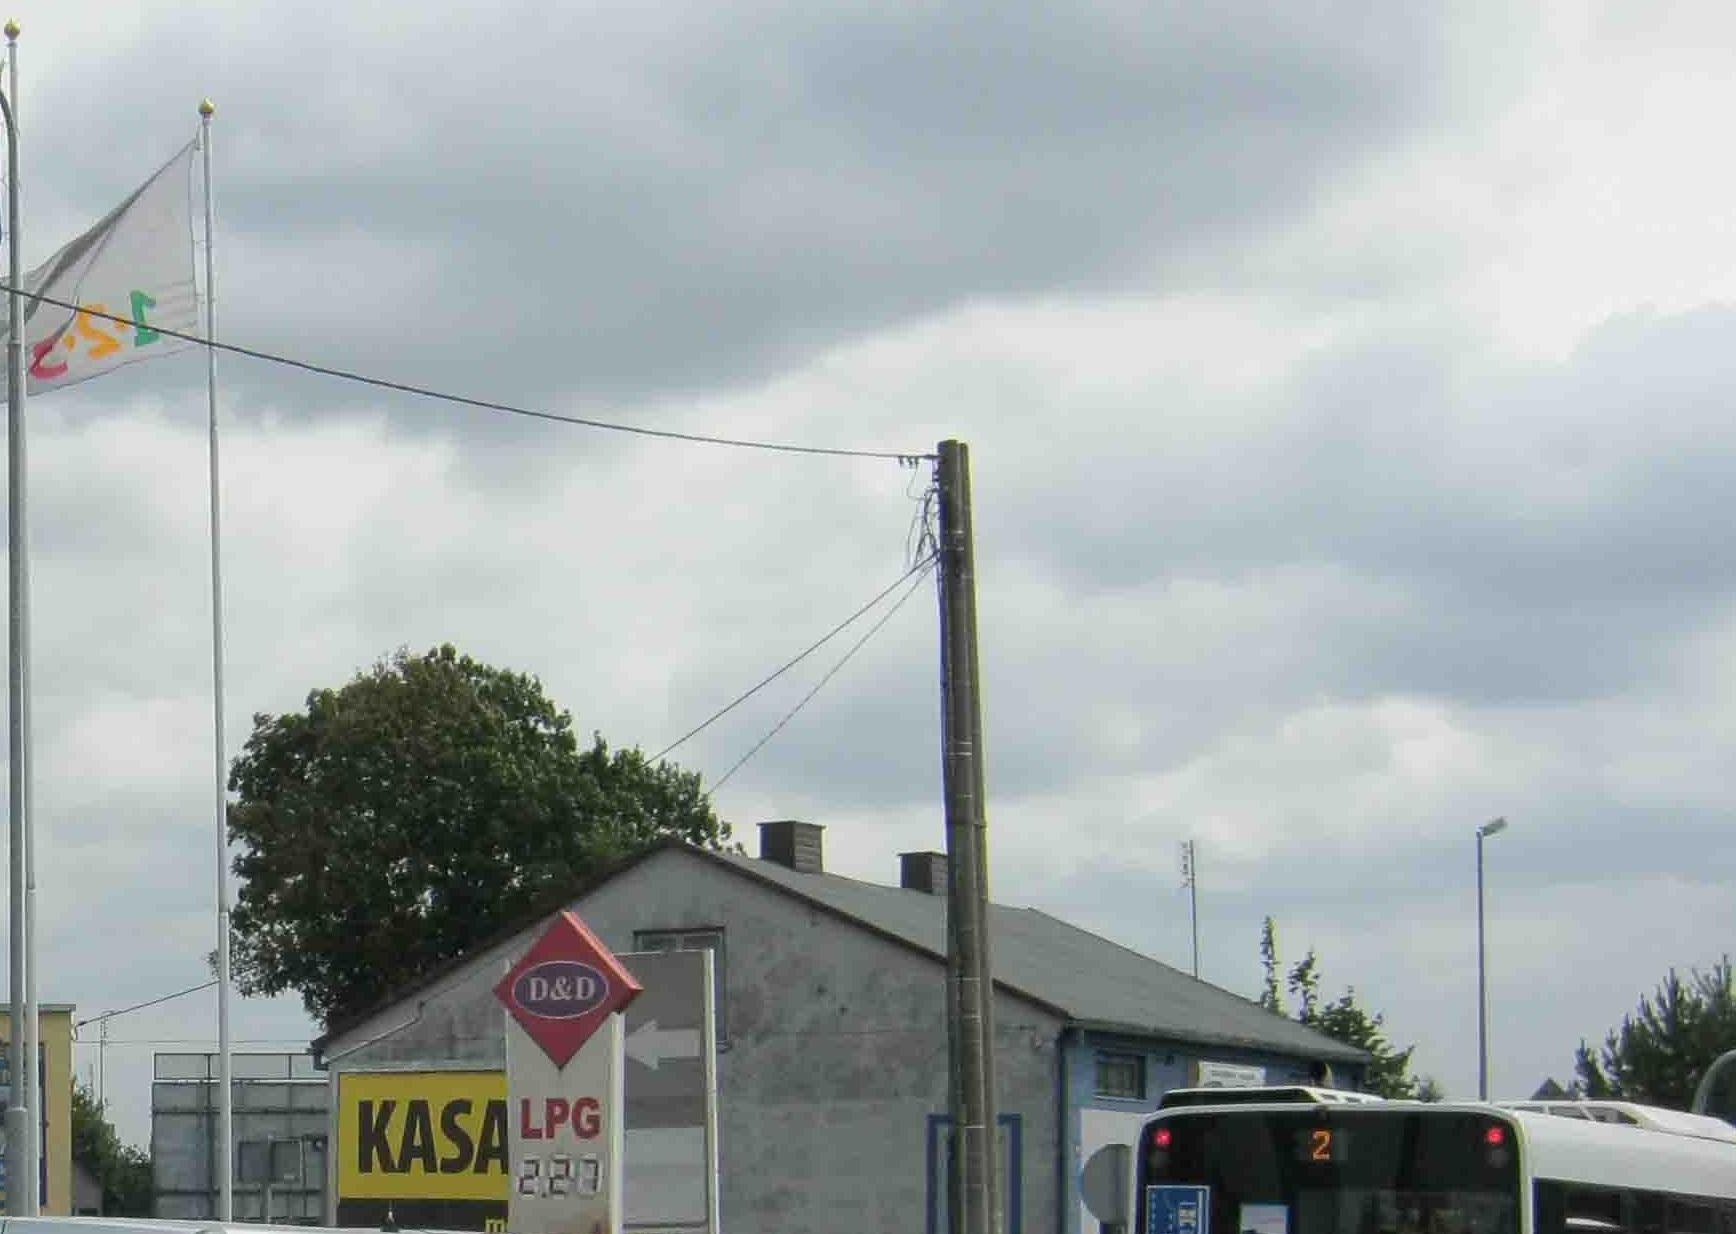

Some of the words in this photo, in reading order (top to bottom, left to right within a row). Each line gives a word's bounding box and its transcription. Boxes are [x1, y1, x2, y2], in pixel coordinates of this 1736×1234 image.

[529, 976, 596, 1001] D&D
[358, 1098, 509, 1174] KASA
[520, 1097, 601, 1140] LPG
[1312, 1130, 1331, 1160] 2
